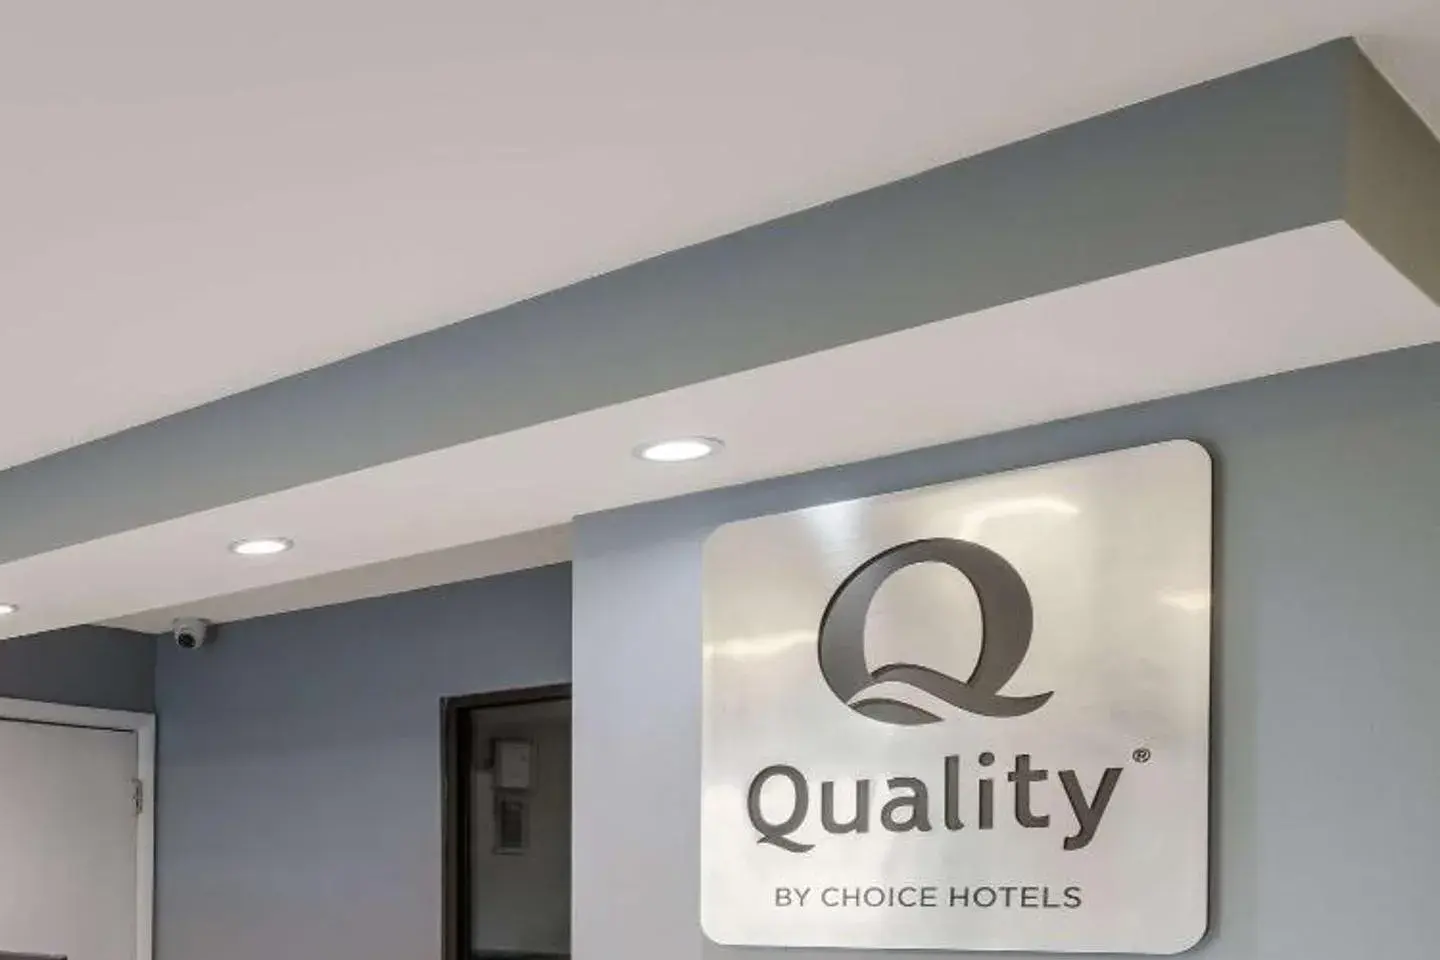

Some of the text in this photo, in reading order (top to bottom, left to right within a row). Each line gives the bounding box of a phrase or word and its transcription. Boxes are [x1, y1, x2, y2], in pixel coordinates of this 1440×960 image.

[817, 536, 1055, 726] Q
[746, 751, 1124, 853] Quality
[774, 886, 1082, 909] BY CHOICE HOTELS
